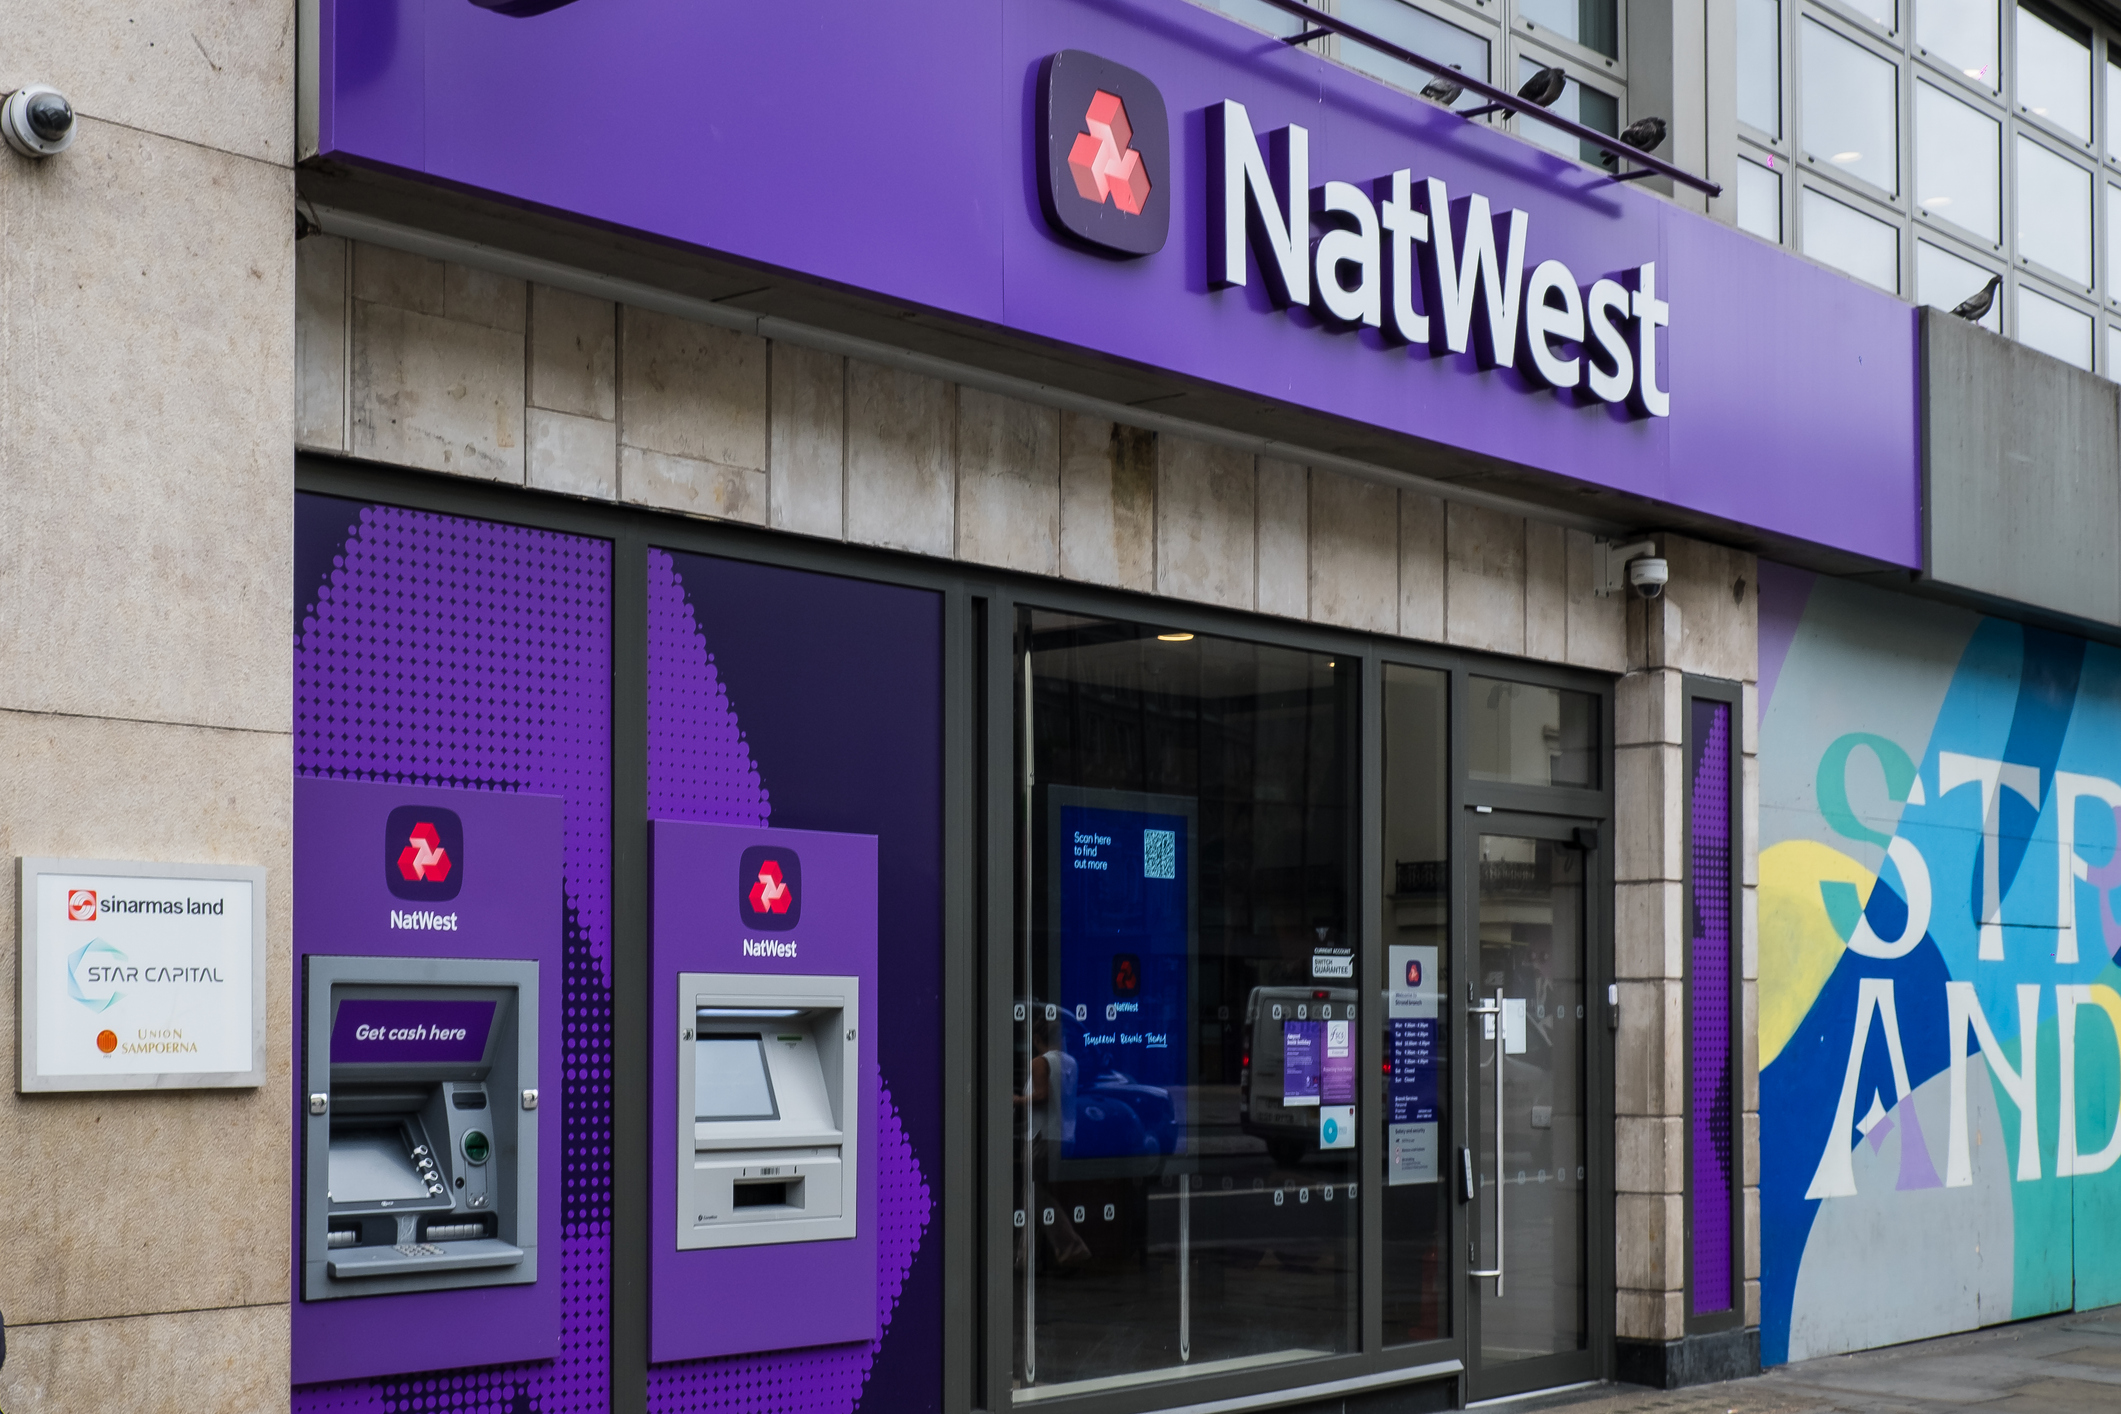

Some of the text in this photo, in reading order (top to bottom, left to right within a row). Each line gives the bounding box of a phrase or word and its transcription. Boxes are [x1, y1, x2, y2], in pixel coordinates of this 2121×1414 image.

[1224, 99, 1670, 417] NatWest
[1074, 831, 1111, 846] Scan here
[1074, 845, 1097, 857] to find
[1074, 859, 1108, 871] out more
[101, 896, 224, 915] sinarmas land
[390, 909, 458, 931] NatWest
[743, 938, 797, 958] NatWest
[88, 967, 224, 982] STAR CAPITAL
[138, 1029, 182, 1040] UNION
[356, 1024, 466, 1041] Get cash here
[122, 1042, 198, 1054] SAMPOERNA
[1804, 978, 2121, 1200] AND
